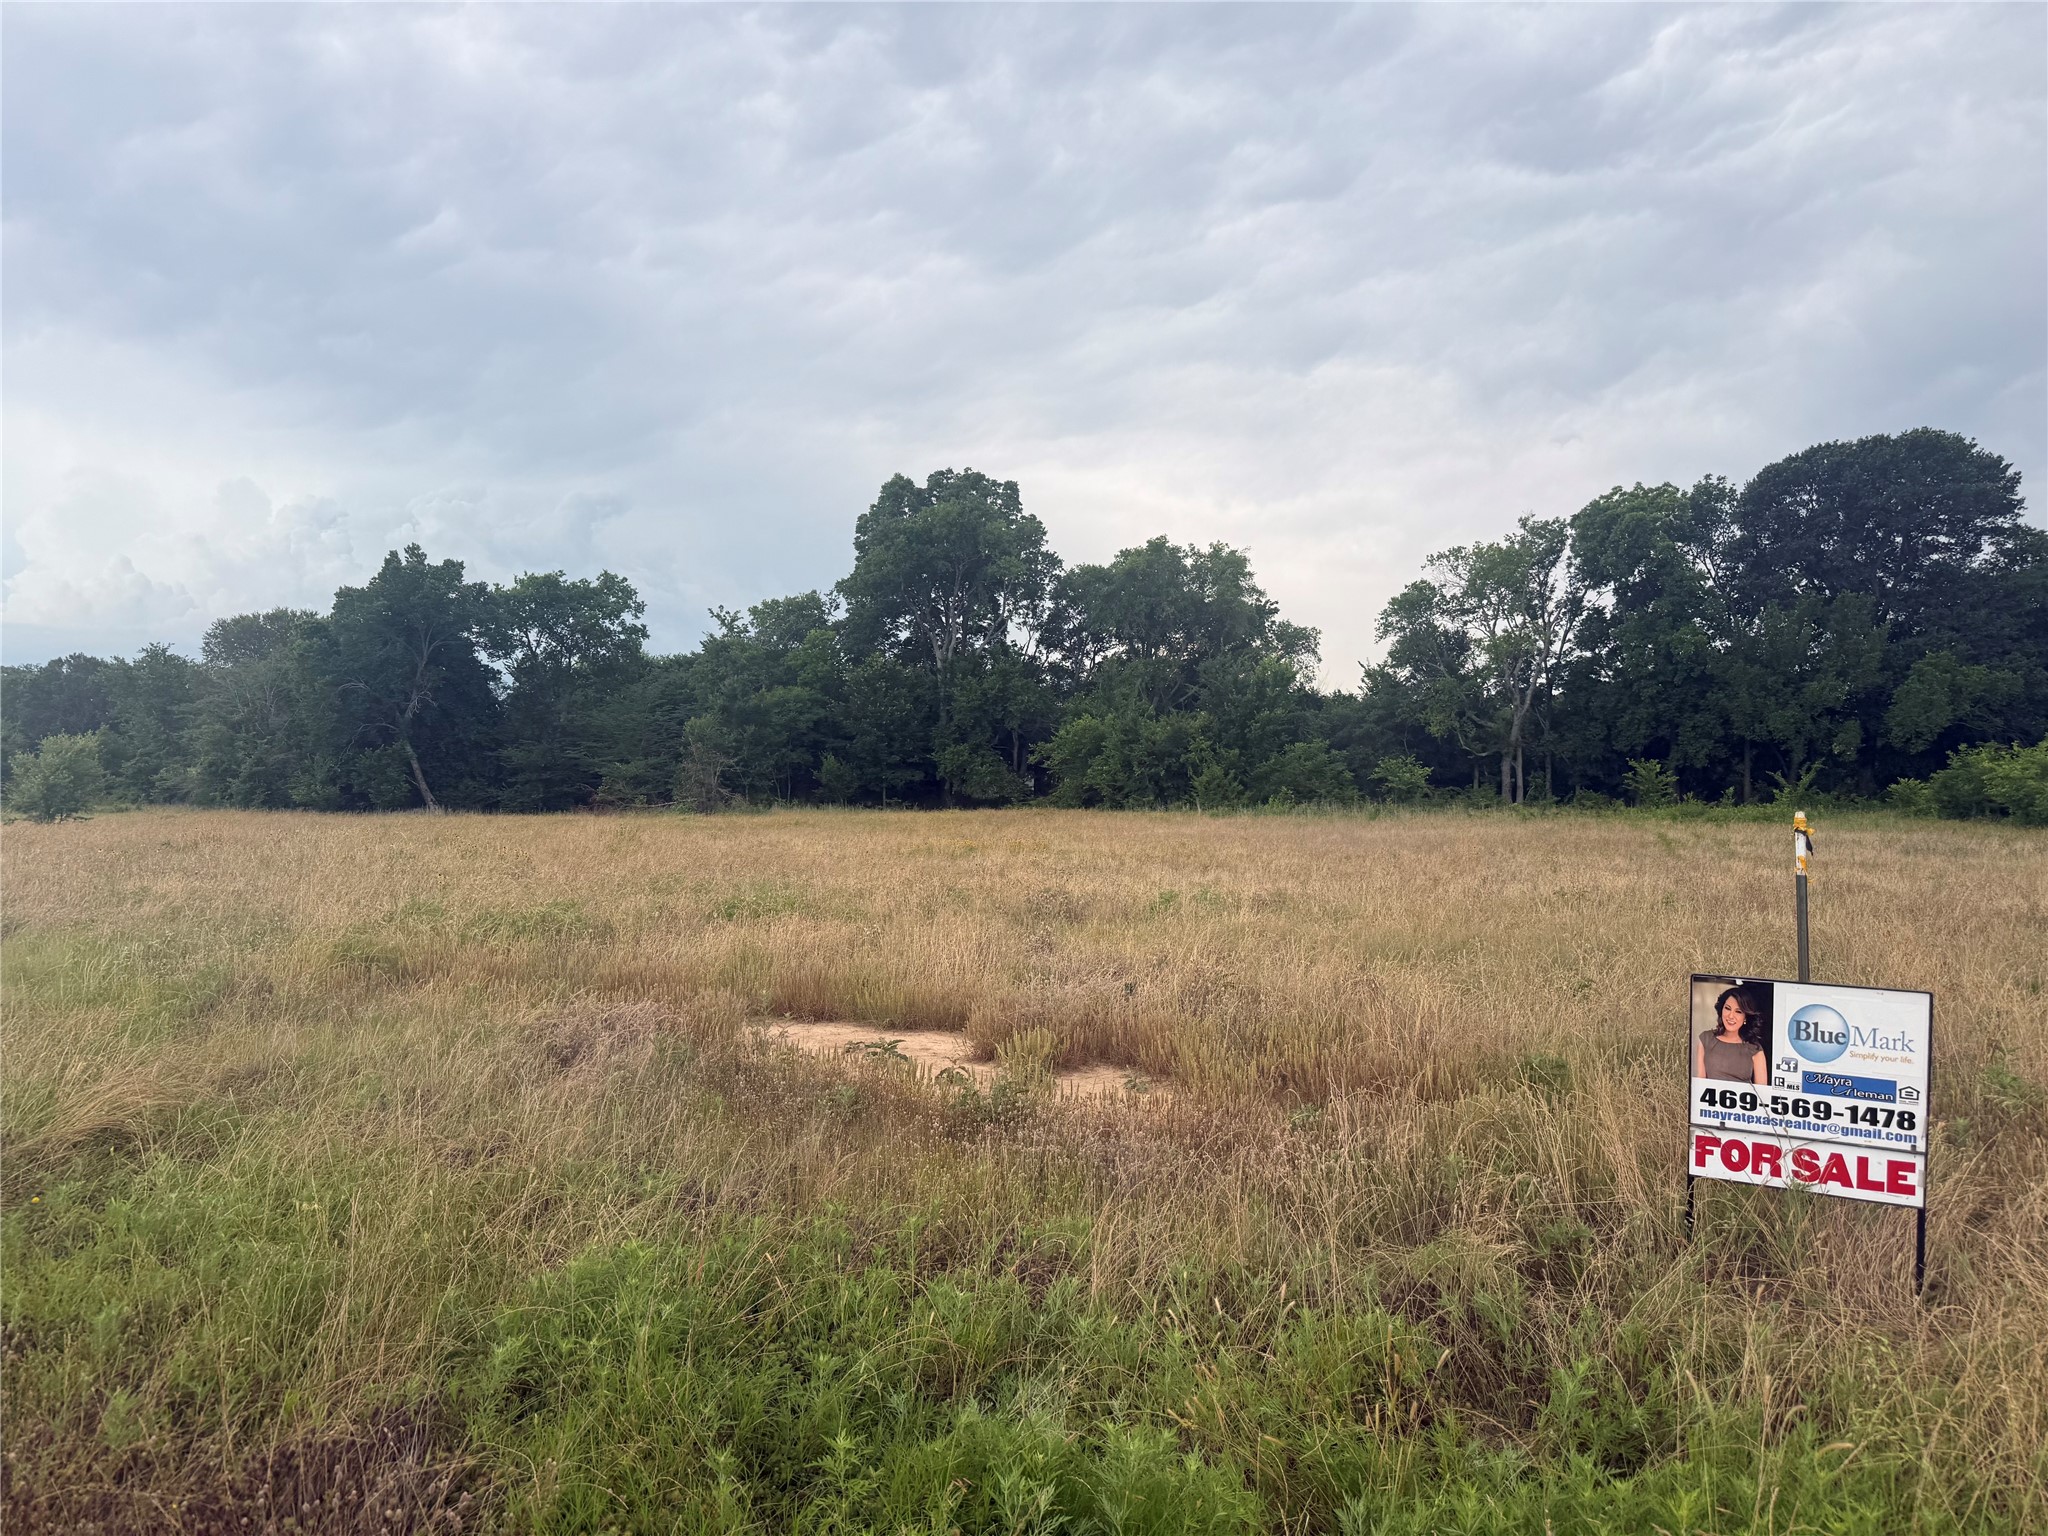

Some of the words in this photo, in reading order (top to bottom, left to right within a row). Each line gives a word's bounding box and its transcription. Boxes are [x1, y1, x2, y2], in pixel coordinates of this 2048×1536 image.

[1793, 1020, 1847, 1046] Blue
[1850, 1025, 1915, 1053] Mark
[1849, 1050, 1878, 1062] Simplify
[1880, 1055, 1898, 1065] your
[1805, 1072, 1852, 1088] Mayra
[1831, 1088, 1894, 1101] Aleman
[1699, 1087, 1916, 1131] 469-569-1478
[1699, 1108, 1917, 1144] mayratexasrealtor@gmail.com
[1695, 1135, 1782, 1178] FOR
[1791, 1148, 1916, 1196] SALE
